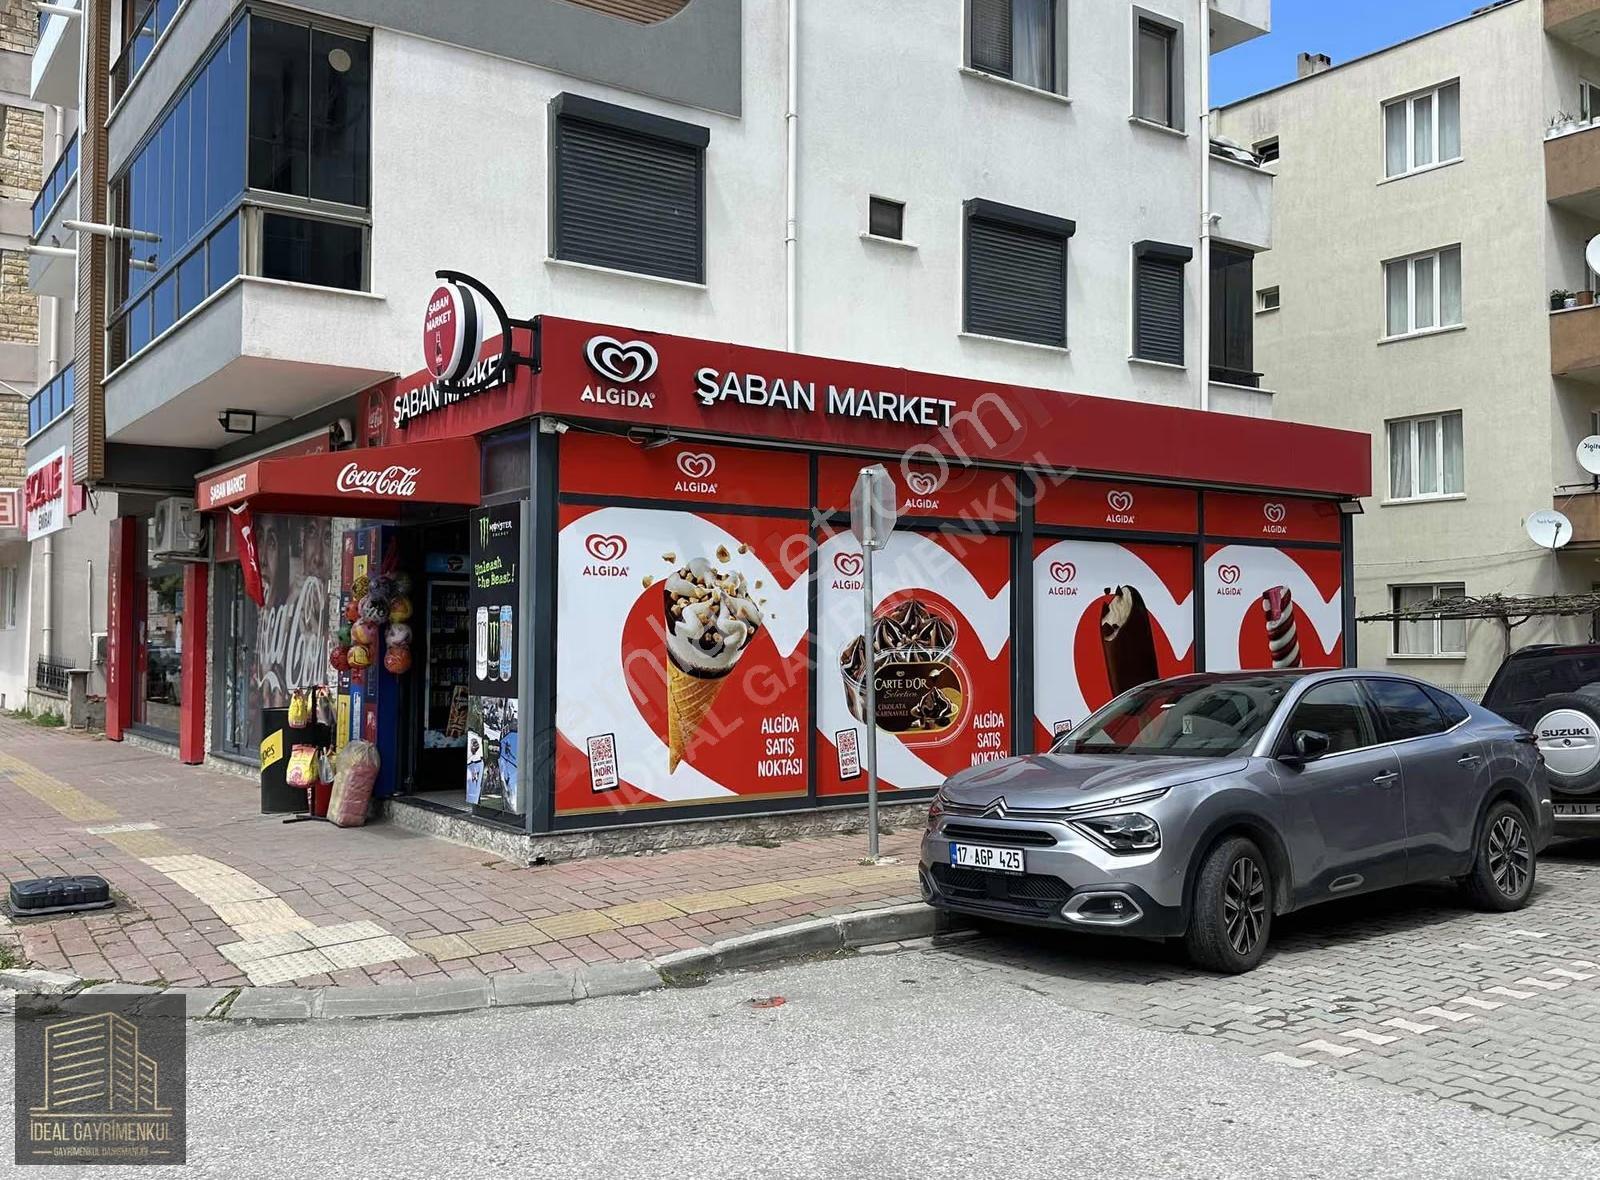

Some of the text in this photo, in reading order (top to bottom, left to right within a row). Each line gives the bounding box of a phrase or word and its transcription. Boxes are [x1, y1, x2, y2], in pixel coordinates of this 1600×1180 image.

[428, 295, 449, 318] ŞABAN
[426, 310, 452, 333] MARKET
[393, 380, 439, 428] ŞABAN
[696, 367, 956, 428] ŞABAN MARKET
[337, 463, 422, 496] Coca-Cola
[874, 678, 905, 691] CARTE
[977, 732, 1001, 749] SATIŞ
[1541, 728, 1590, 737] SUZUKI
[766, 737, 795, 755] SATIŞ
[757, 758, 803, 777] NOKTASI
[957, 846, 1020, 869] 17 AGP 425
